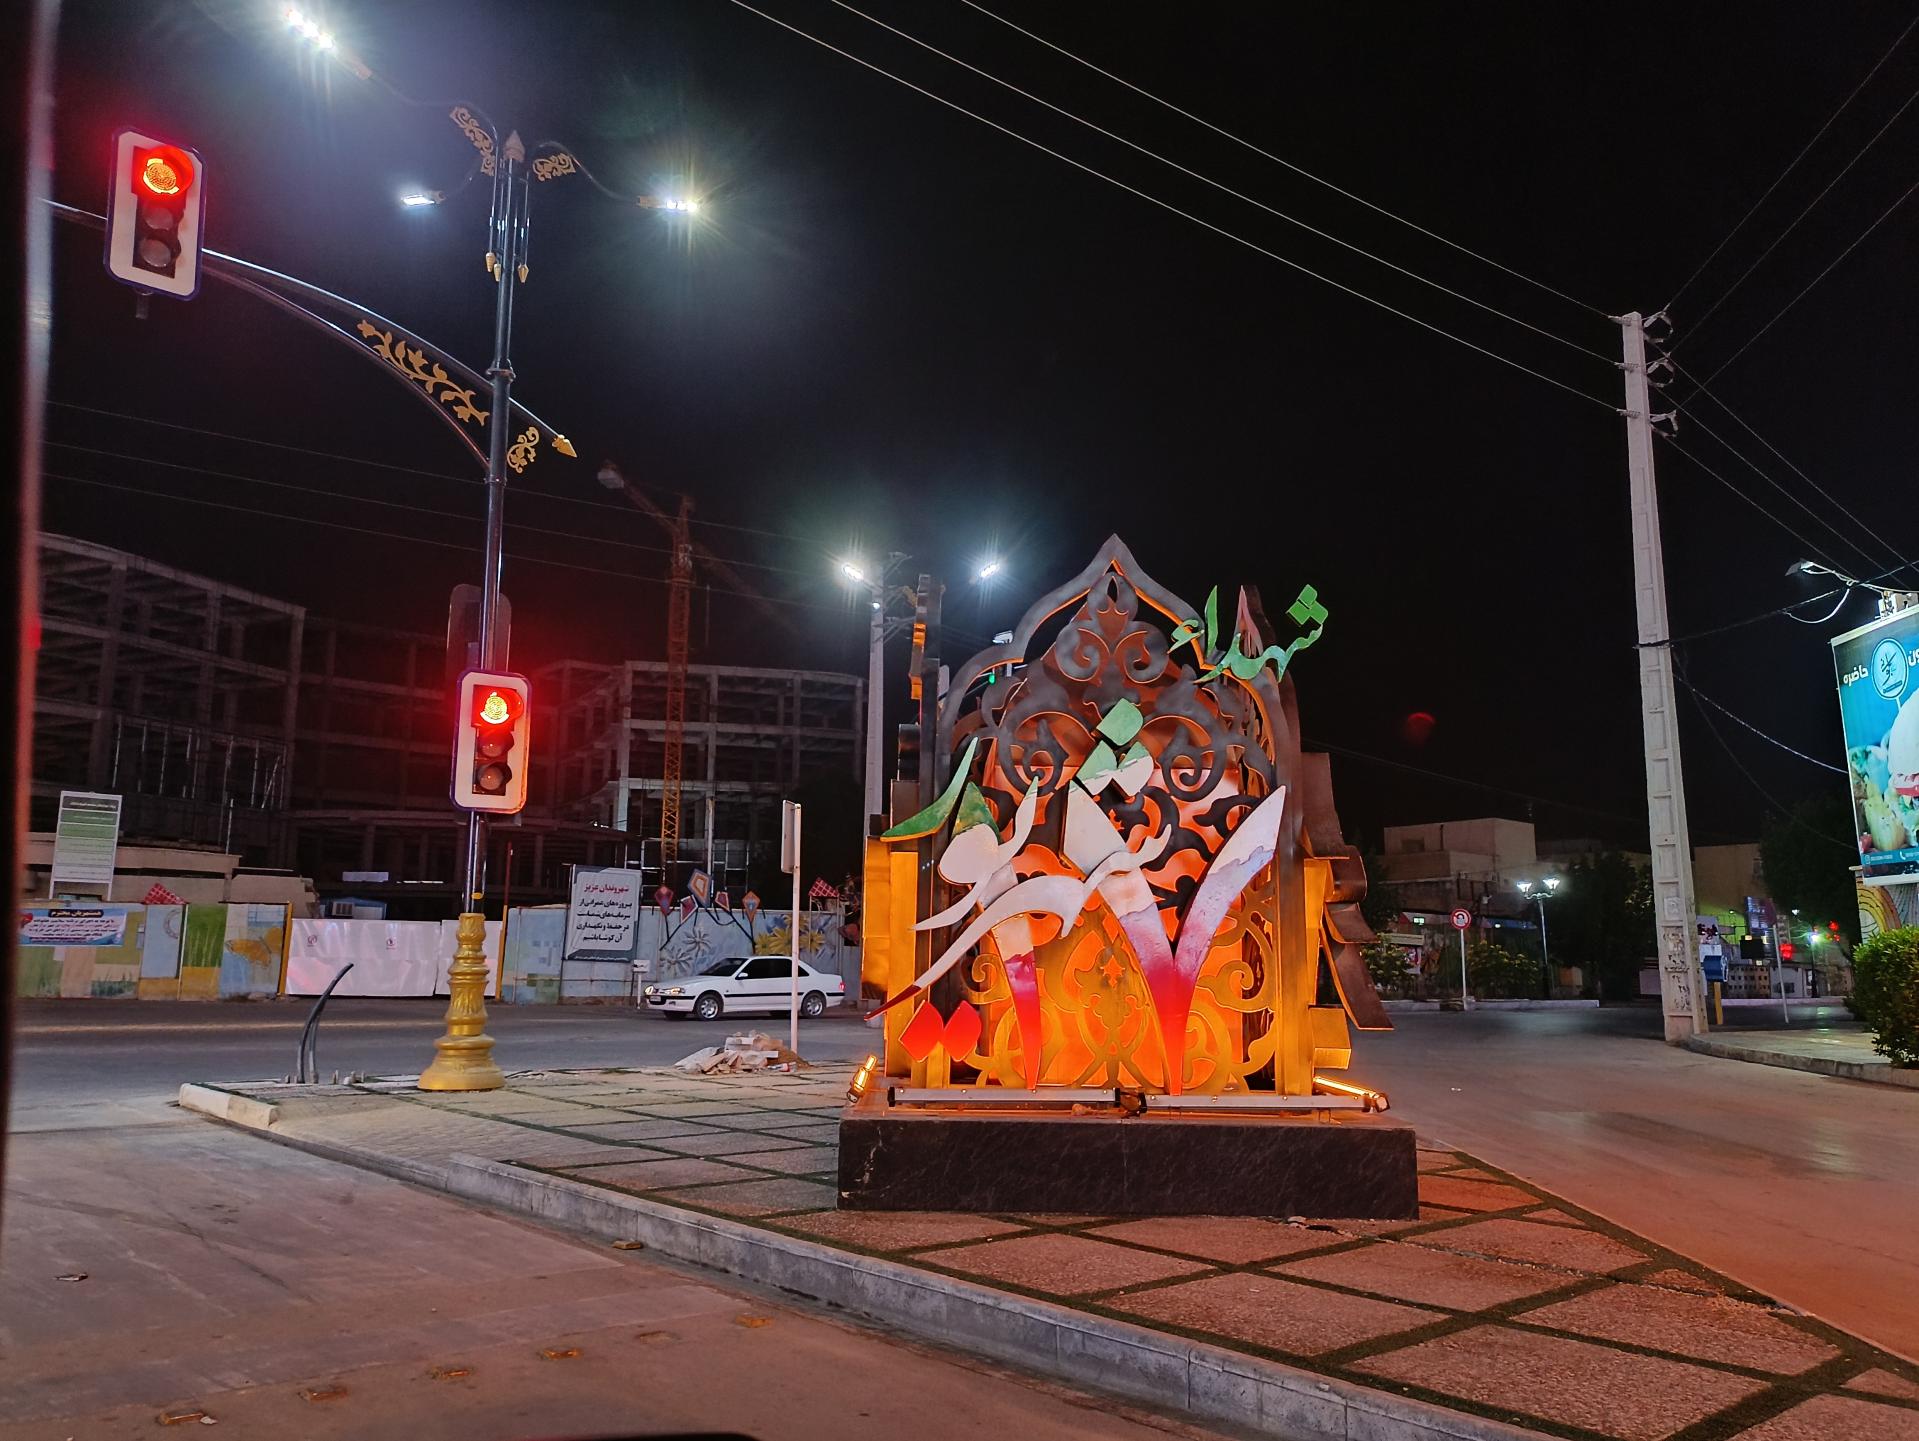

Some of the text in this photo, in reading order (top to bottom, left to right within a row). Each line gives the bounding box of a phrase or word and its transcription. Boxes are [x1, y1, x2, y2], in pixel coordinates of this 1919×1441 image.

[1843, 664, 1869, 687] حاضره
[583, 882, 629, 893] شهروندان عزیز
[576, 922, 603, 930] نگهداری
[614, 933, 622, 943] آن
